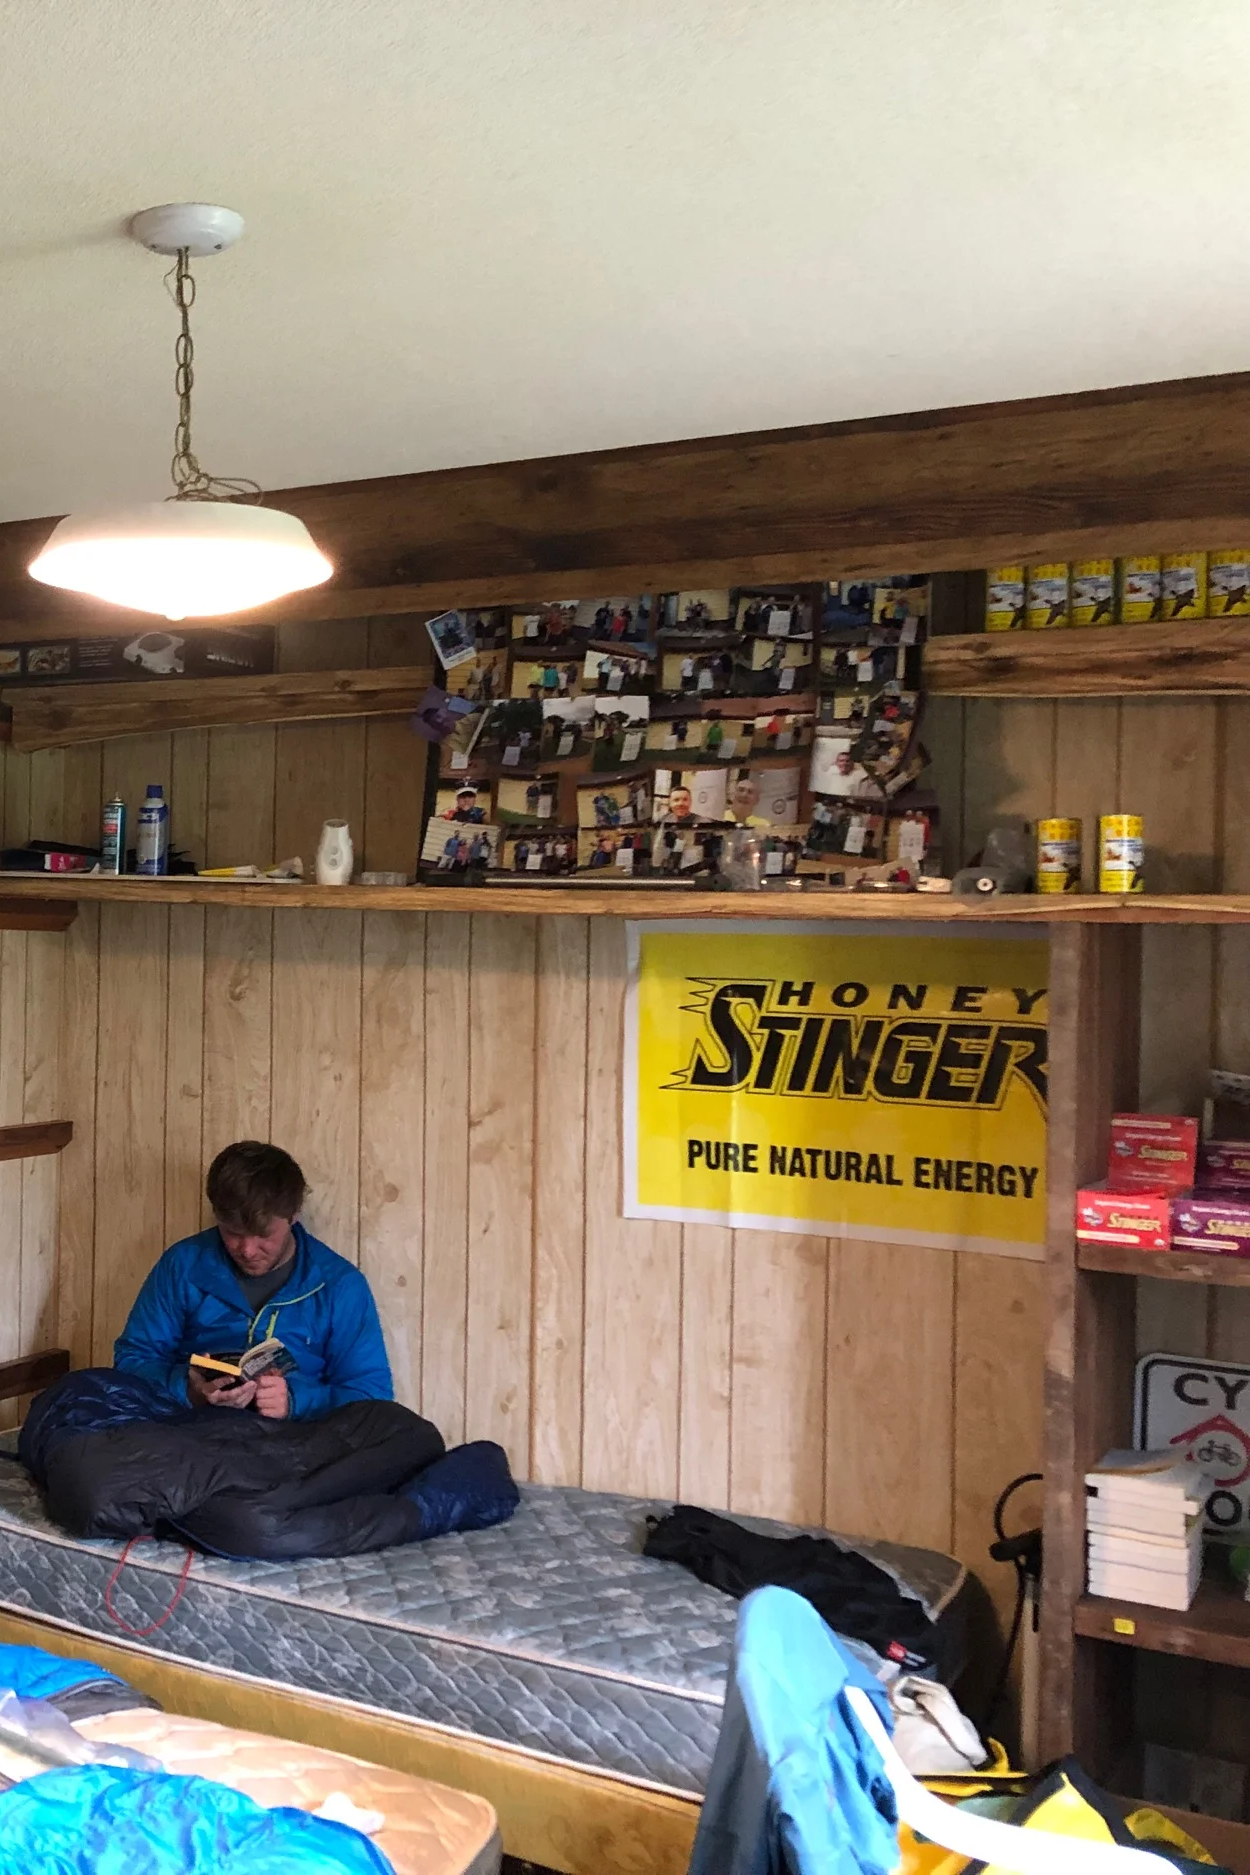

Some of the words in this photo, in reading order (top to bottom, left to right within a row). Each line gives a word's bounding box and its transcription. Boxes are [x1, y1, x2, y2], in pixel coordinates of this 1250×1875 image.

[777, 981, 1048, 1014] HONEY
[688, 983, 1048, 1105] STINGER
[687, 1139, 759, 1173] PURE
[769, 1145, 904, 1187] NATURAL
[913, 1157, 1039, 1199] ENERGY
[1174, 1373, 1249, 1410] CY
